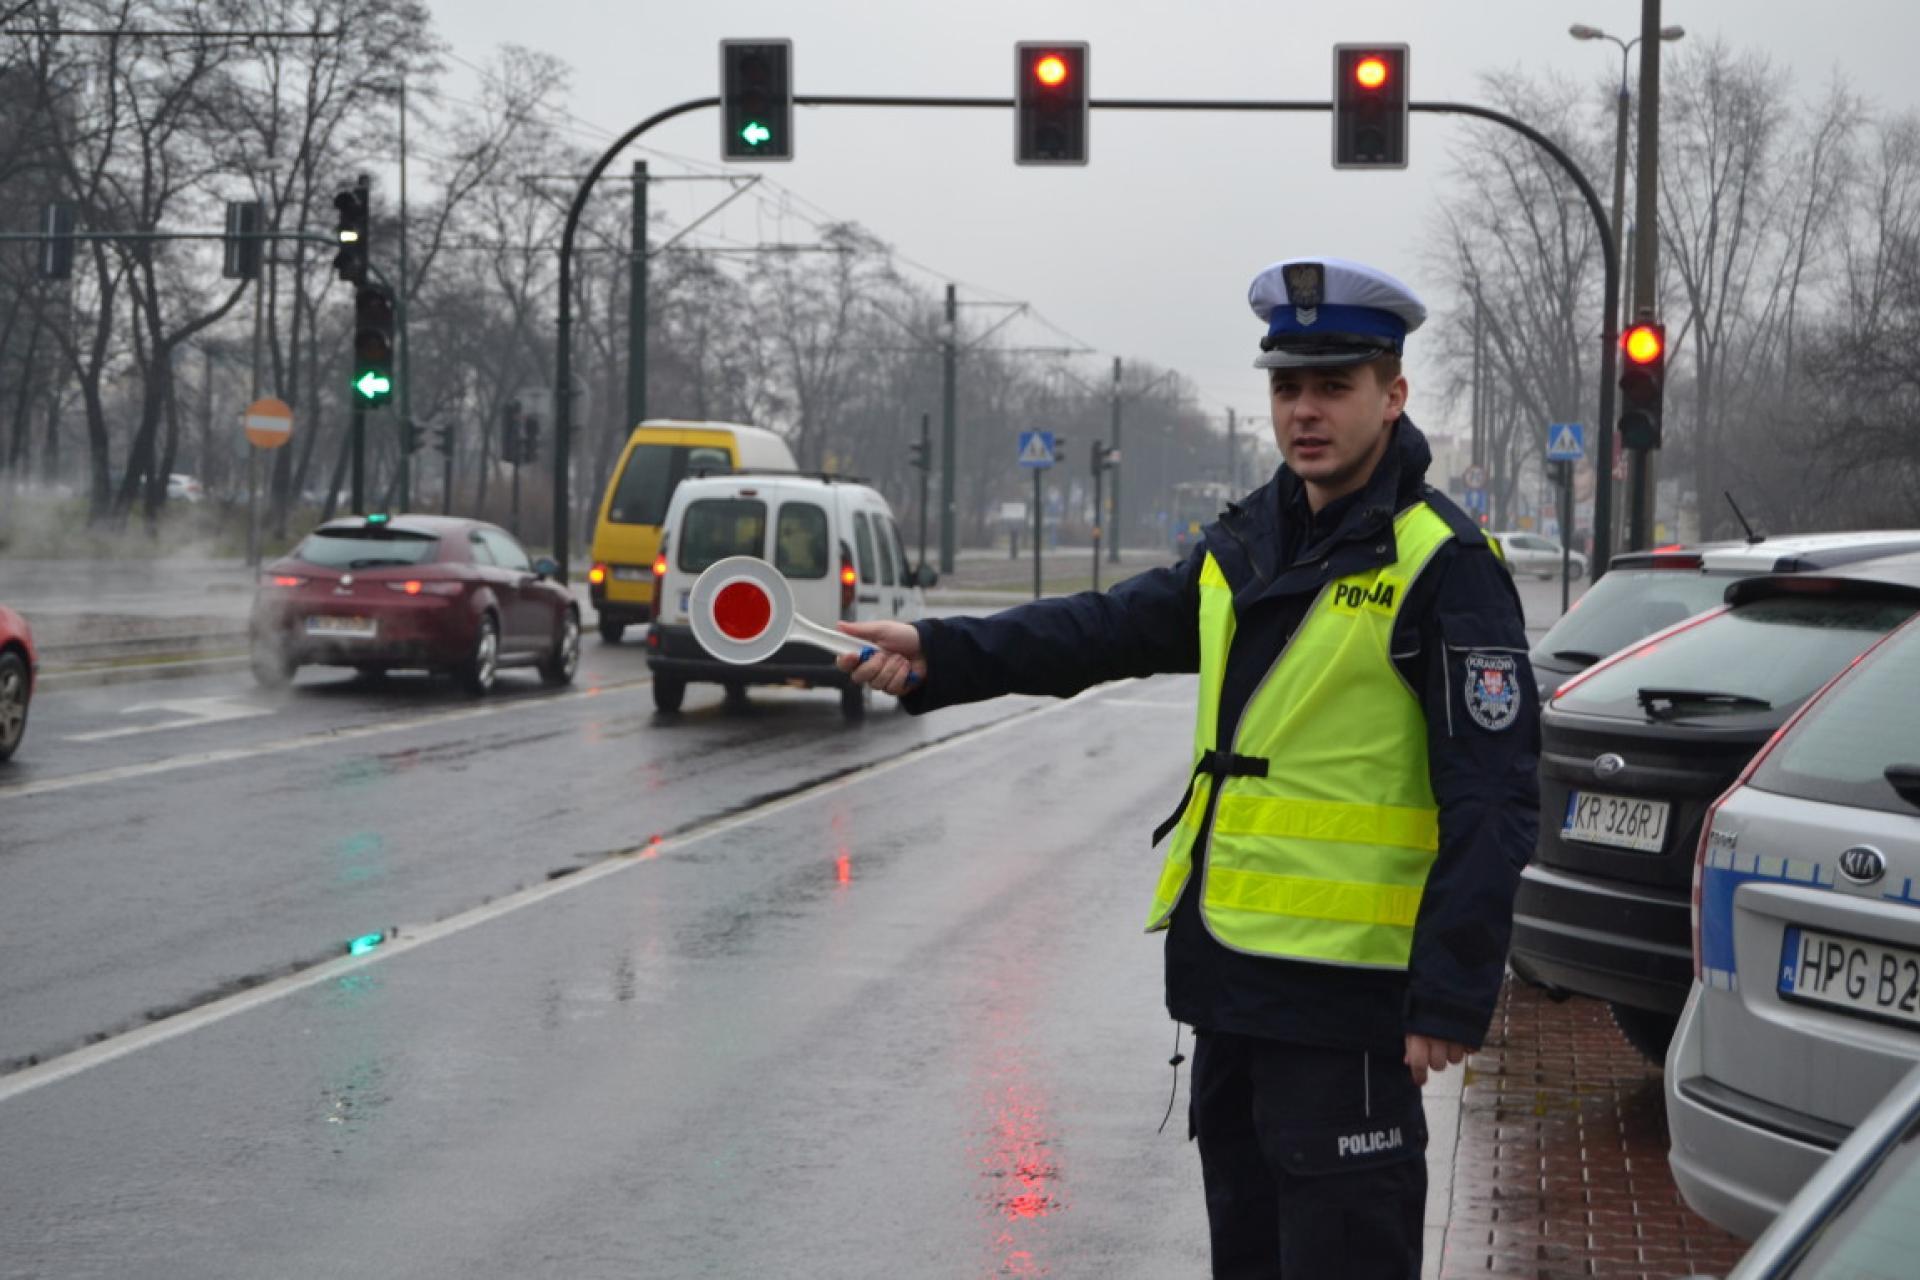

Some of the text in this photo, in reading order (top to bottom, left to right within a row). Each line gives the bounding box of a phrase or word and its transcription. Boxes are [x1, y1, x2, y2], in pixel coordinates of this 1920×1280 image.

[1575, 795, 1665, 840] KR 326RJ
[1846, 851, 1876, 876] KIA
[1798, 937, 1920, 1012] HPG B2
[1337, 1126, 1404, 1157] POLICJA
